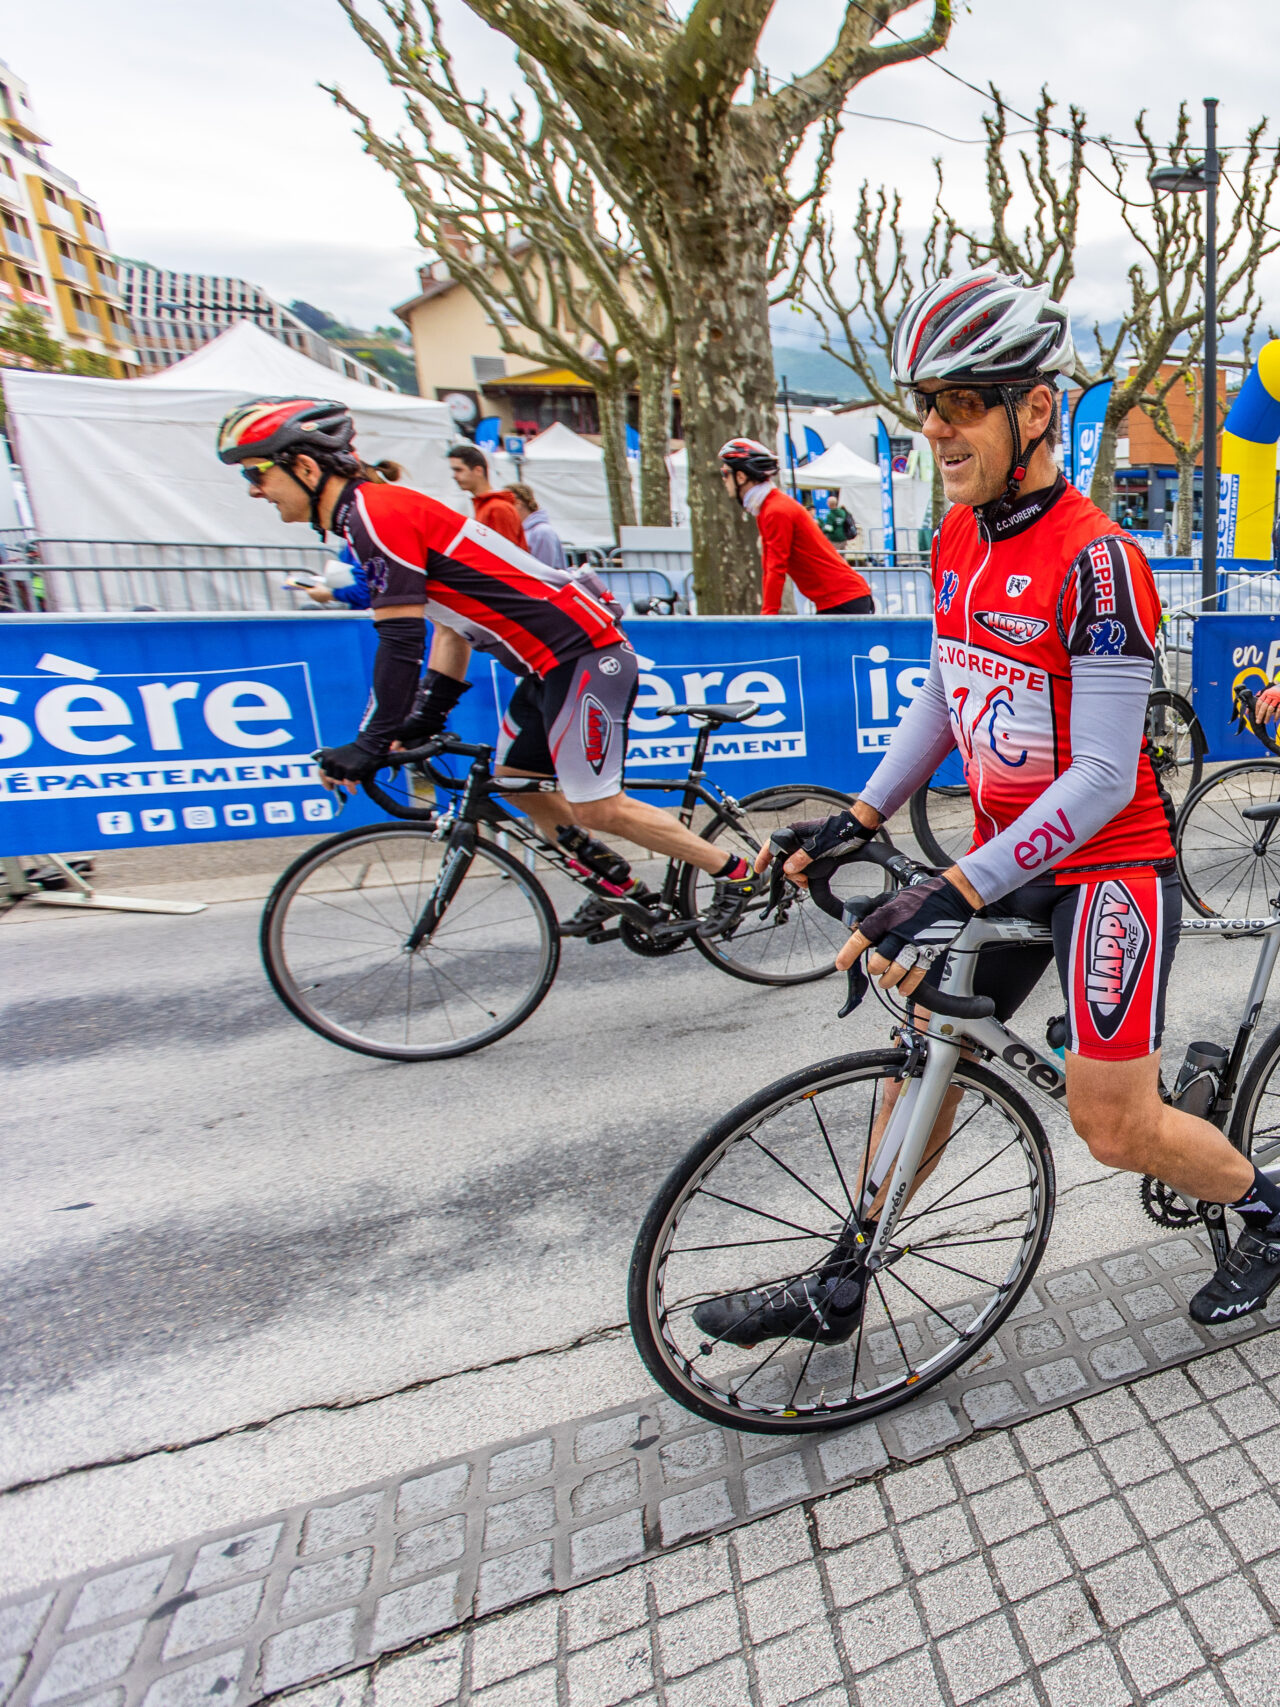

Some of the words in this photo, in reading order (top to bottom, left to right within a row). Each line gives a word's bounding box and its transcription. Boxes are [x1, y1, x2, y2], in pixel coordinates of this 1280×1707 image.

[986, 611, 1037, 638] HAPPY
[1232, 645, 1264, 668] en
[626, 738, 801, 760] ARTMENT
[863, 734, 892, 747] LE
[1087, 891, 1132, 1005] HAPPY
[1126, 923, 1139, 960] BIKE
[878, 1181, 908, 1247] cervélo
[1210, 1297, 1259, 1317] NW
